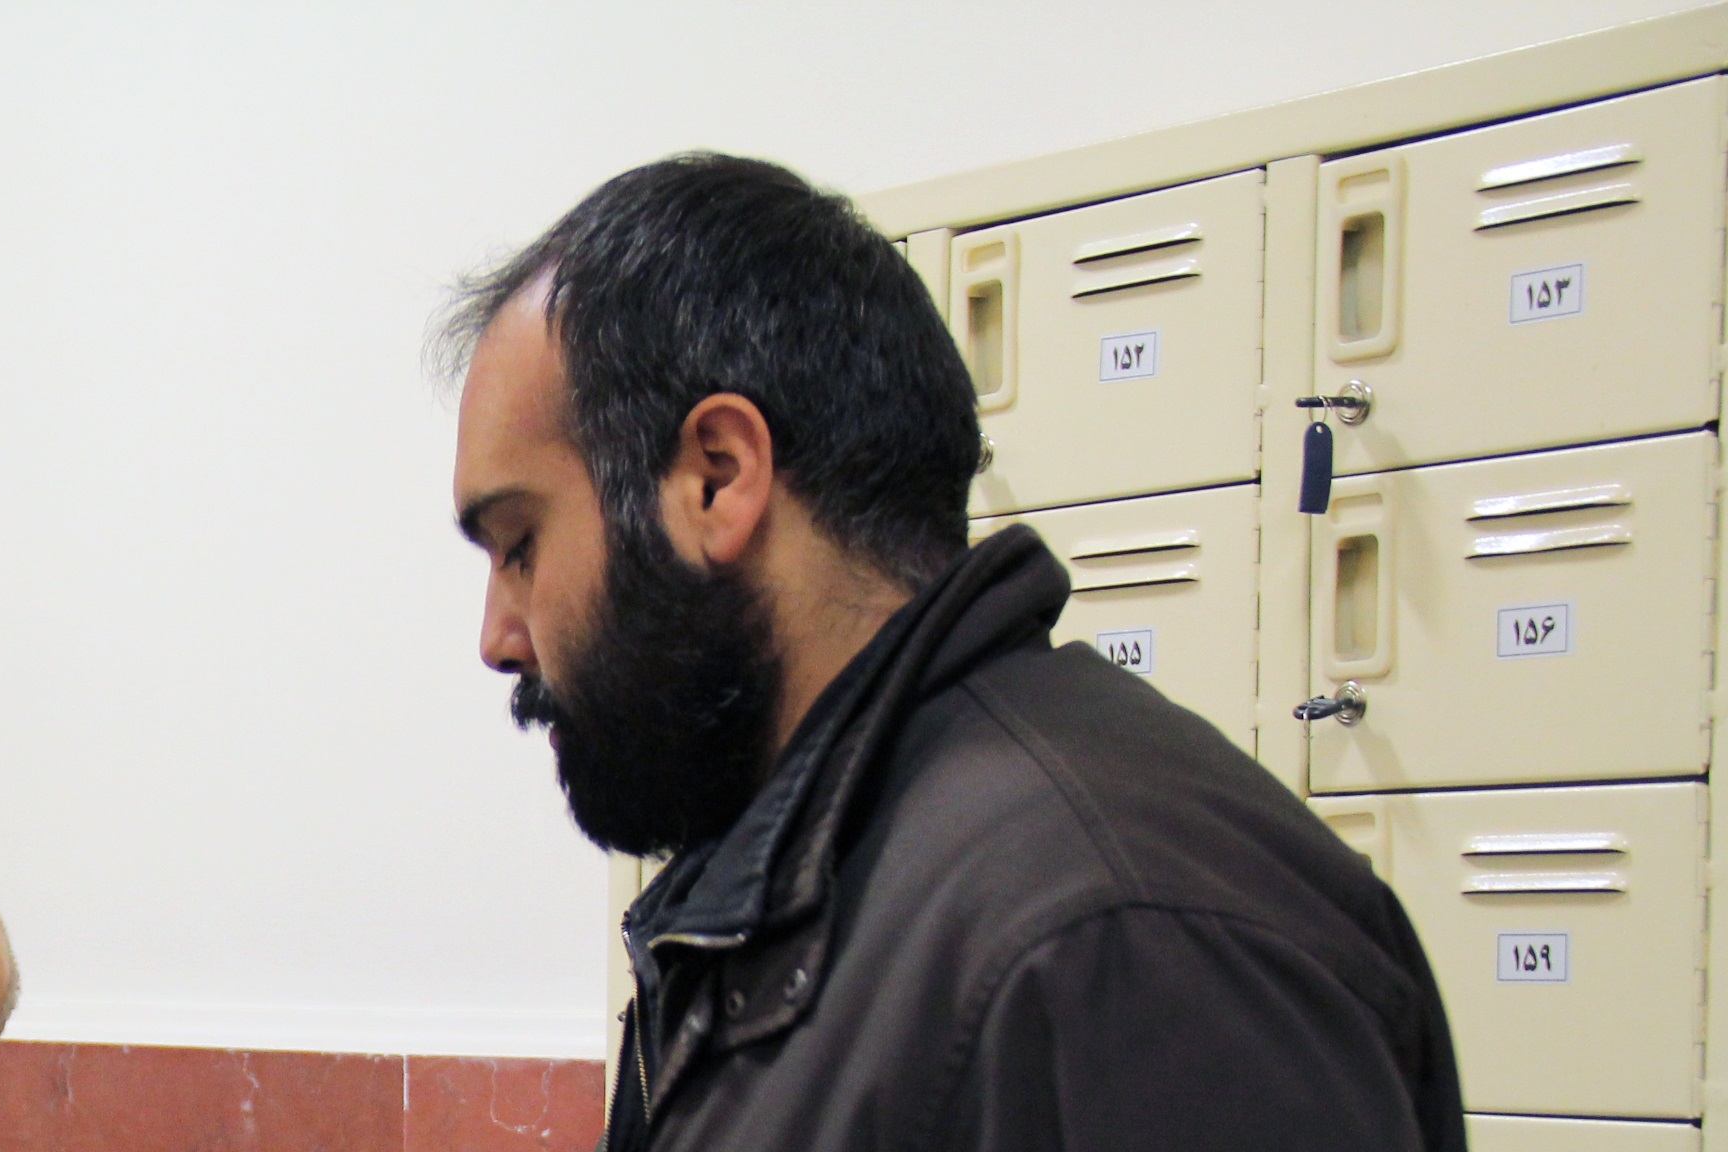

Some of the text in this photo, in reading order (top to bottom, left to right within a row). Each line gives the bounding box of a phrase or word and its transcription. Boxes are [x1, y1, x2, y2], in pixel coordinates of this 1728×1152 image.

[1527, 277, 1572, 311] ۱۵۳
[1113, 343, 1145, 371] ۱۵۲
[1513, 616, 1555, 646] ۱۵۶
[1109, 641, 1141, 666] ۱۵۵
[1513, 943, 1551, 972] ۱۵۹
